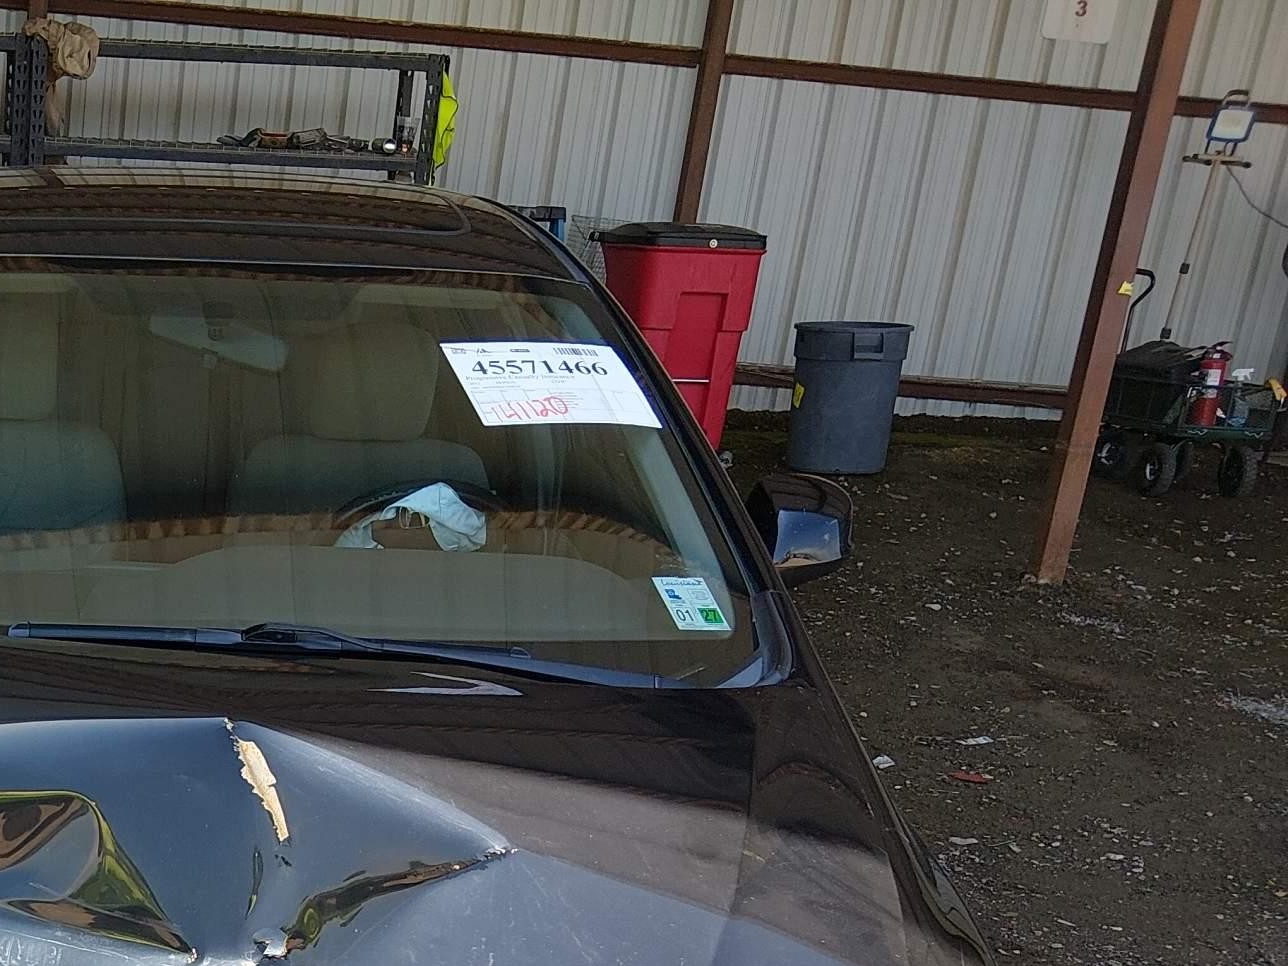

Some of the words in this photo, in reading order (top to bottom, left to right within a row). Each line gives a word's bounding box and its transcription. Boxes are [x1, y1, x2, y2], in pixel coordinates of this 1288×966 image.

[1075, 0, 1088, 17] 3
[472, 360, 608, 376] 45571466
[675, 609, 694, 622] 01
